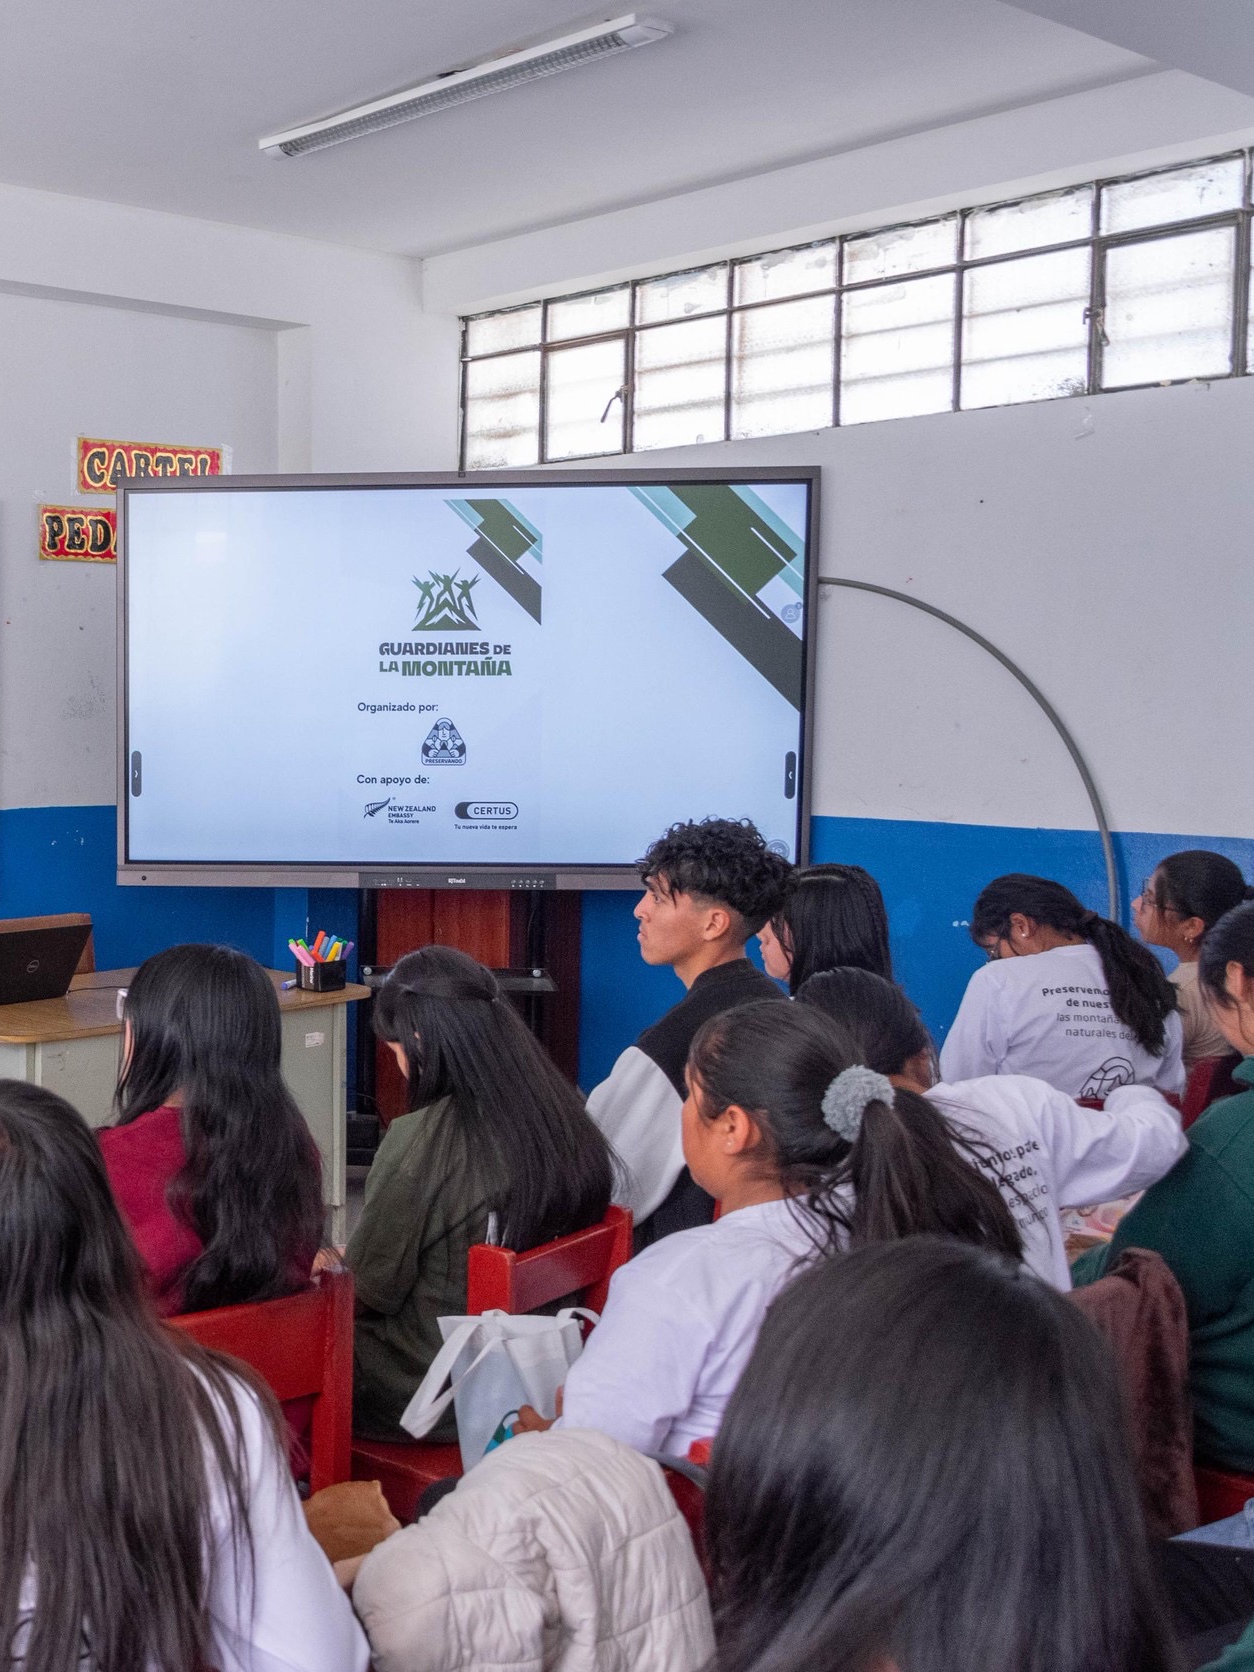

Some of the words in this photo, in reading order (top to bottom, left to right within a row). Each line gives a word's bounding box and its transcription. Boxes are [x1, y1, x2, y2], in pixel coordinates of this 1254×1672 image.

[44, 513, 117, 554] PED
[379, 642, 490, 656] GUARDIANES
[493, 644, 511, 655] DE
[379, 661, 399, 672] LA
[401, 657, 512, 677] MONTAÑA
[357, 702, 416, 714] Organizado
[418, 703, 439, 714] por:
[356, 774, 377, 785] Con
[380, 776, 412, 786] apoyo
[414, 774, 430, 785] de:
[473, 806, 512, 815] CERTUS
[1042, 986, 1110, 997] Preservemo
[1066, 998, 1080, 1007] de
[1082, 1000, 1110, 1009] nues
[1056, 1013, 1071, 1022] las
[1073, 1014, 1120, 1024] montaña
[1065, 1028, 1117, 1039] naturales
